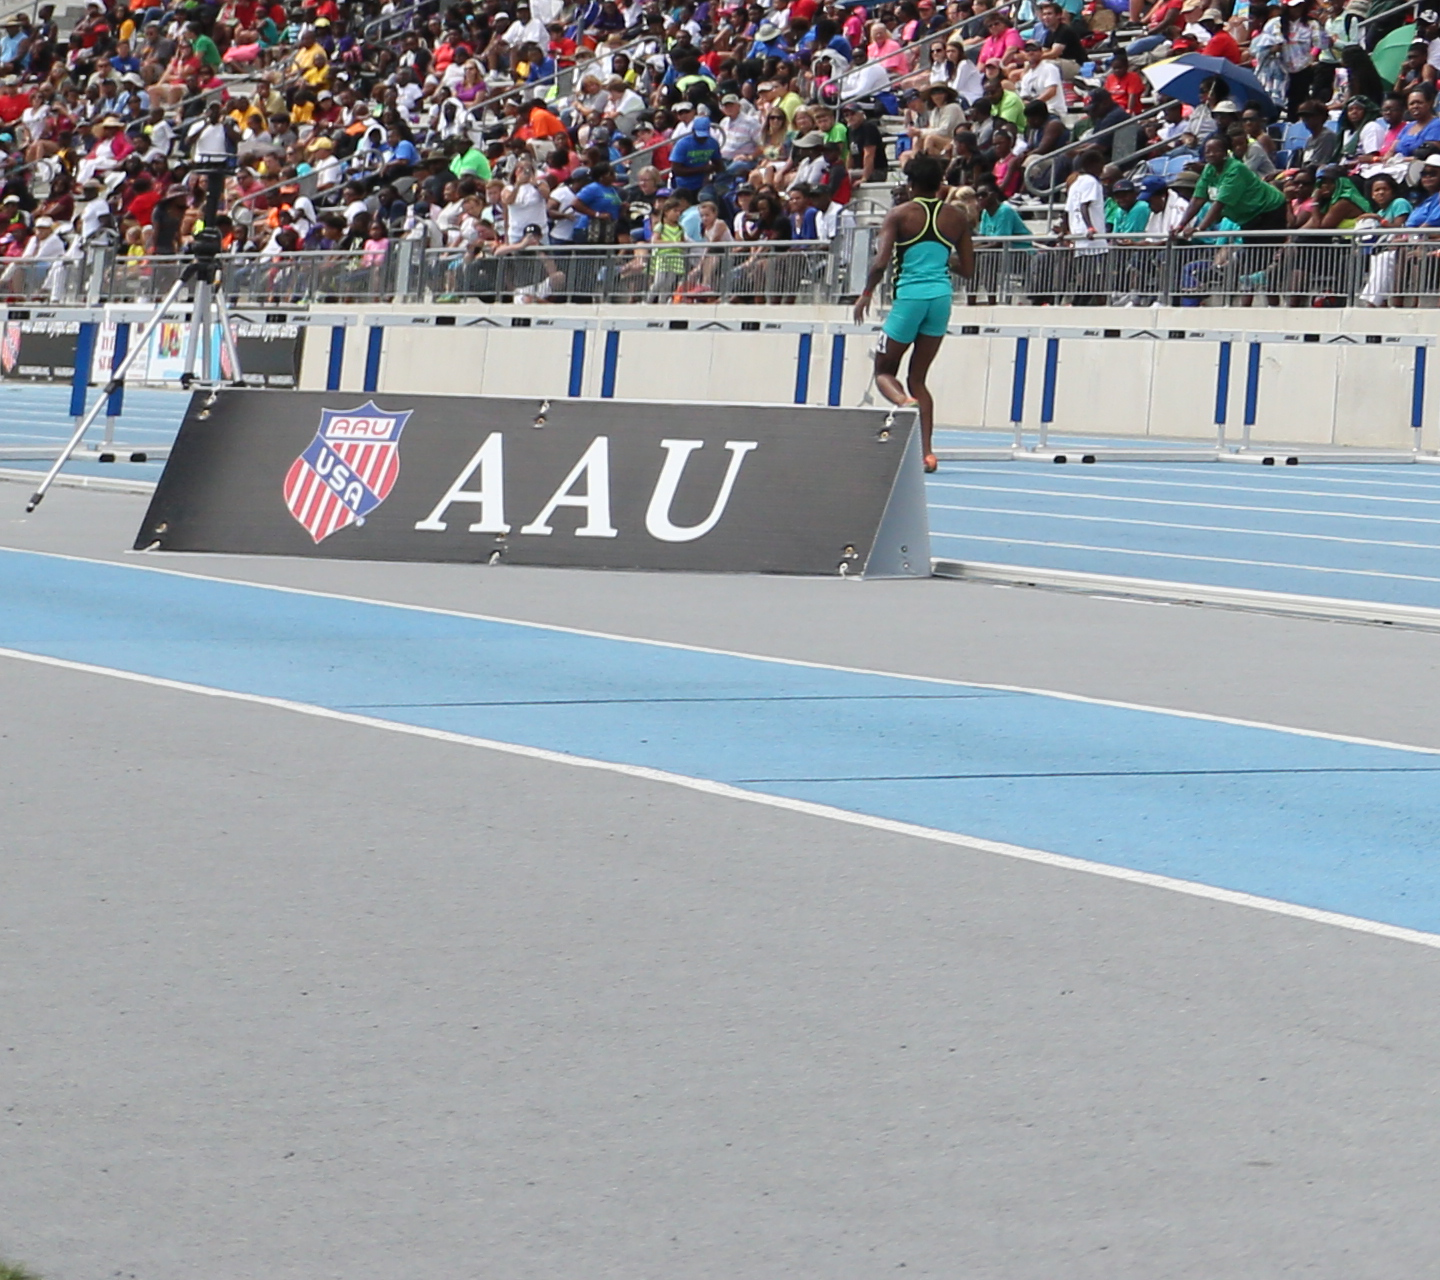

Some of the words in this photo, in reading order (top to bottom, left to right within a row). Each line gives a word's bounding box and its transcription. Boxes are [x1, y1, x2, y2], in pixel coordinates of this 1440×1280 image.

[330, 419, 391, 436] AAU
[315, 446, 365, 511] USA
[414, 431, 758, 542] AAU
